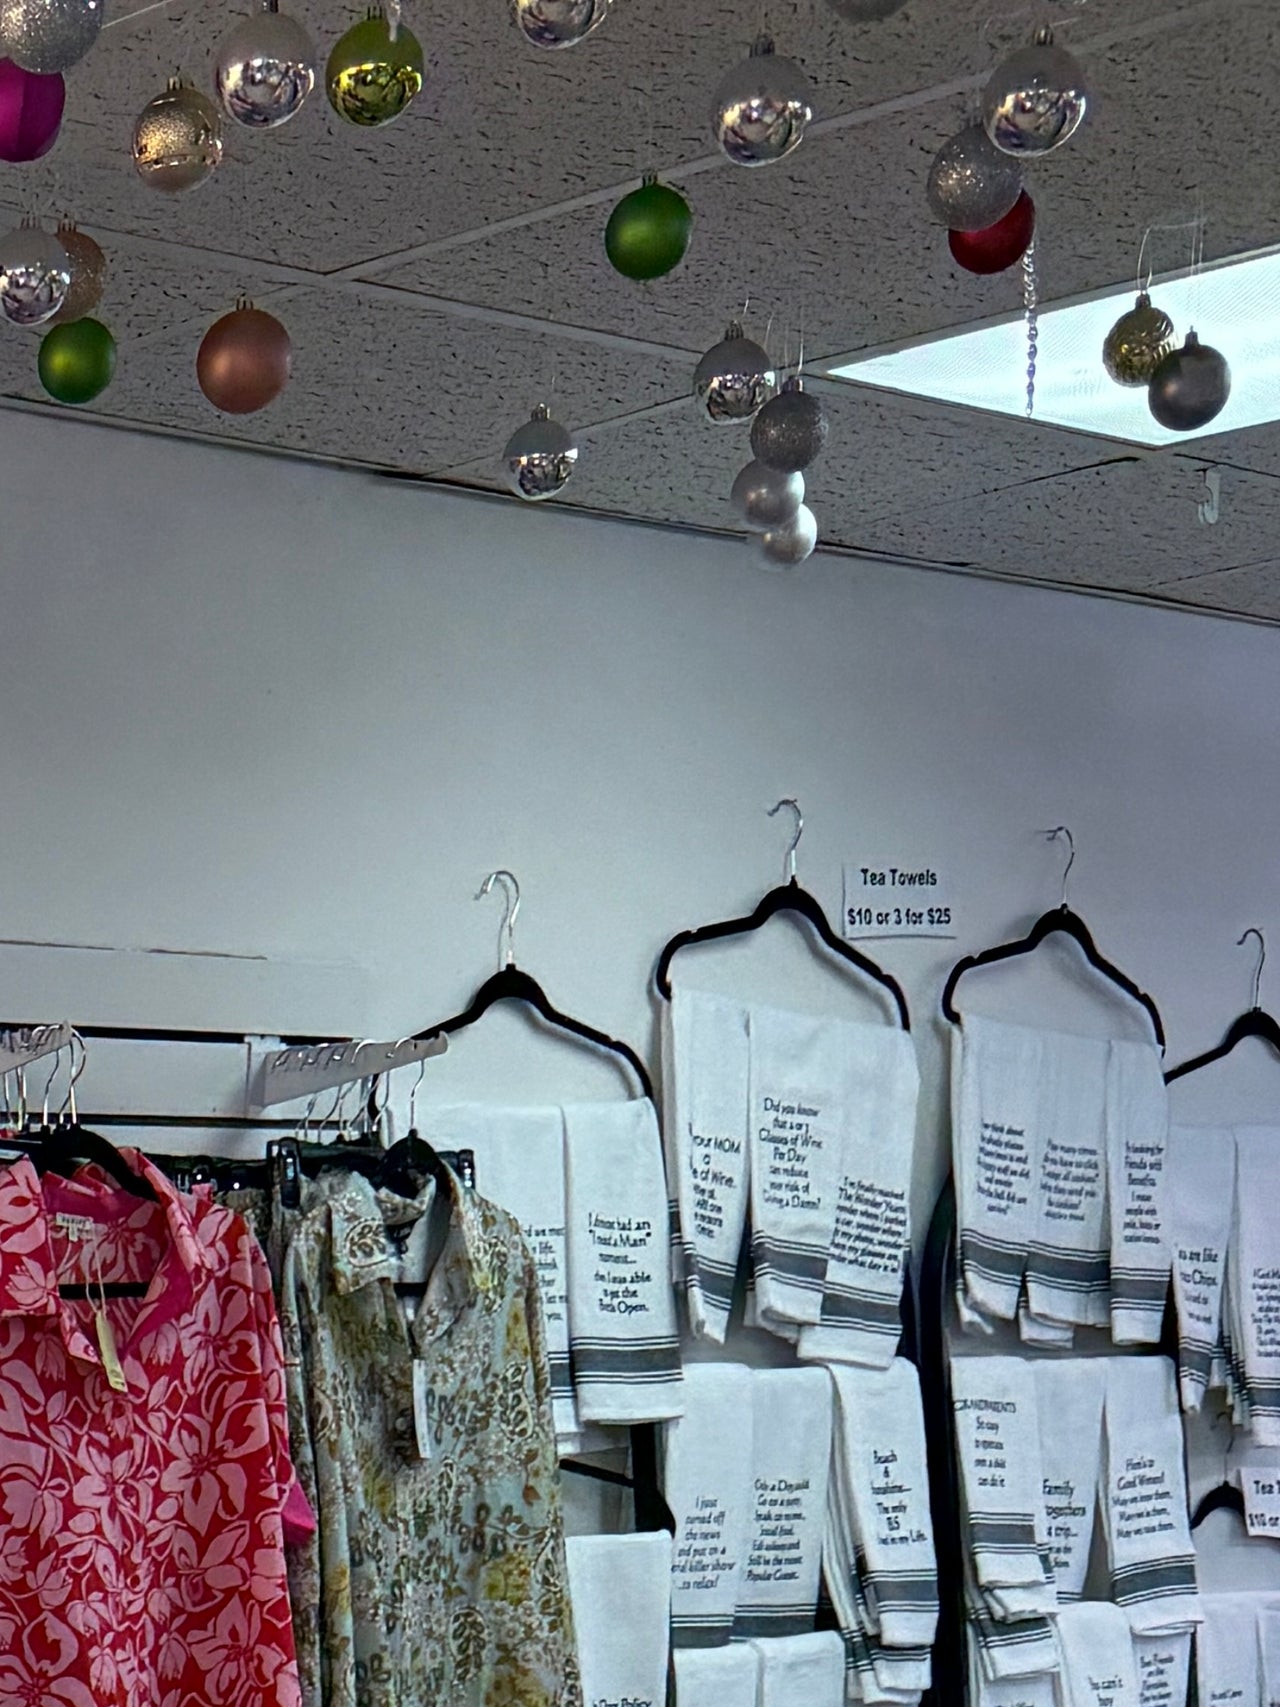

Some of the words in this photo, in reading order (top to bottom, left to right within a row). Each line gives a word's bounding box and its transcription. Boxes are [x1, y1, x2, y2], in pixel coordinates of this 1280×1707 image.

[860, 867, 886, 887] Tea
[888, 867, 938, 887] Towels
[847, 907, 872, 926] $10
[876, 912, 891, 925] or
[893, 907, 903, 925] 3
[905, 907, 924, 925] for
[927, 906, 952, 926] $25
[1042, 1479, 1076, 1498] Family
[1252, 1480, 1274, 1495] Tea
